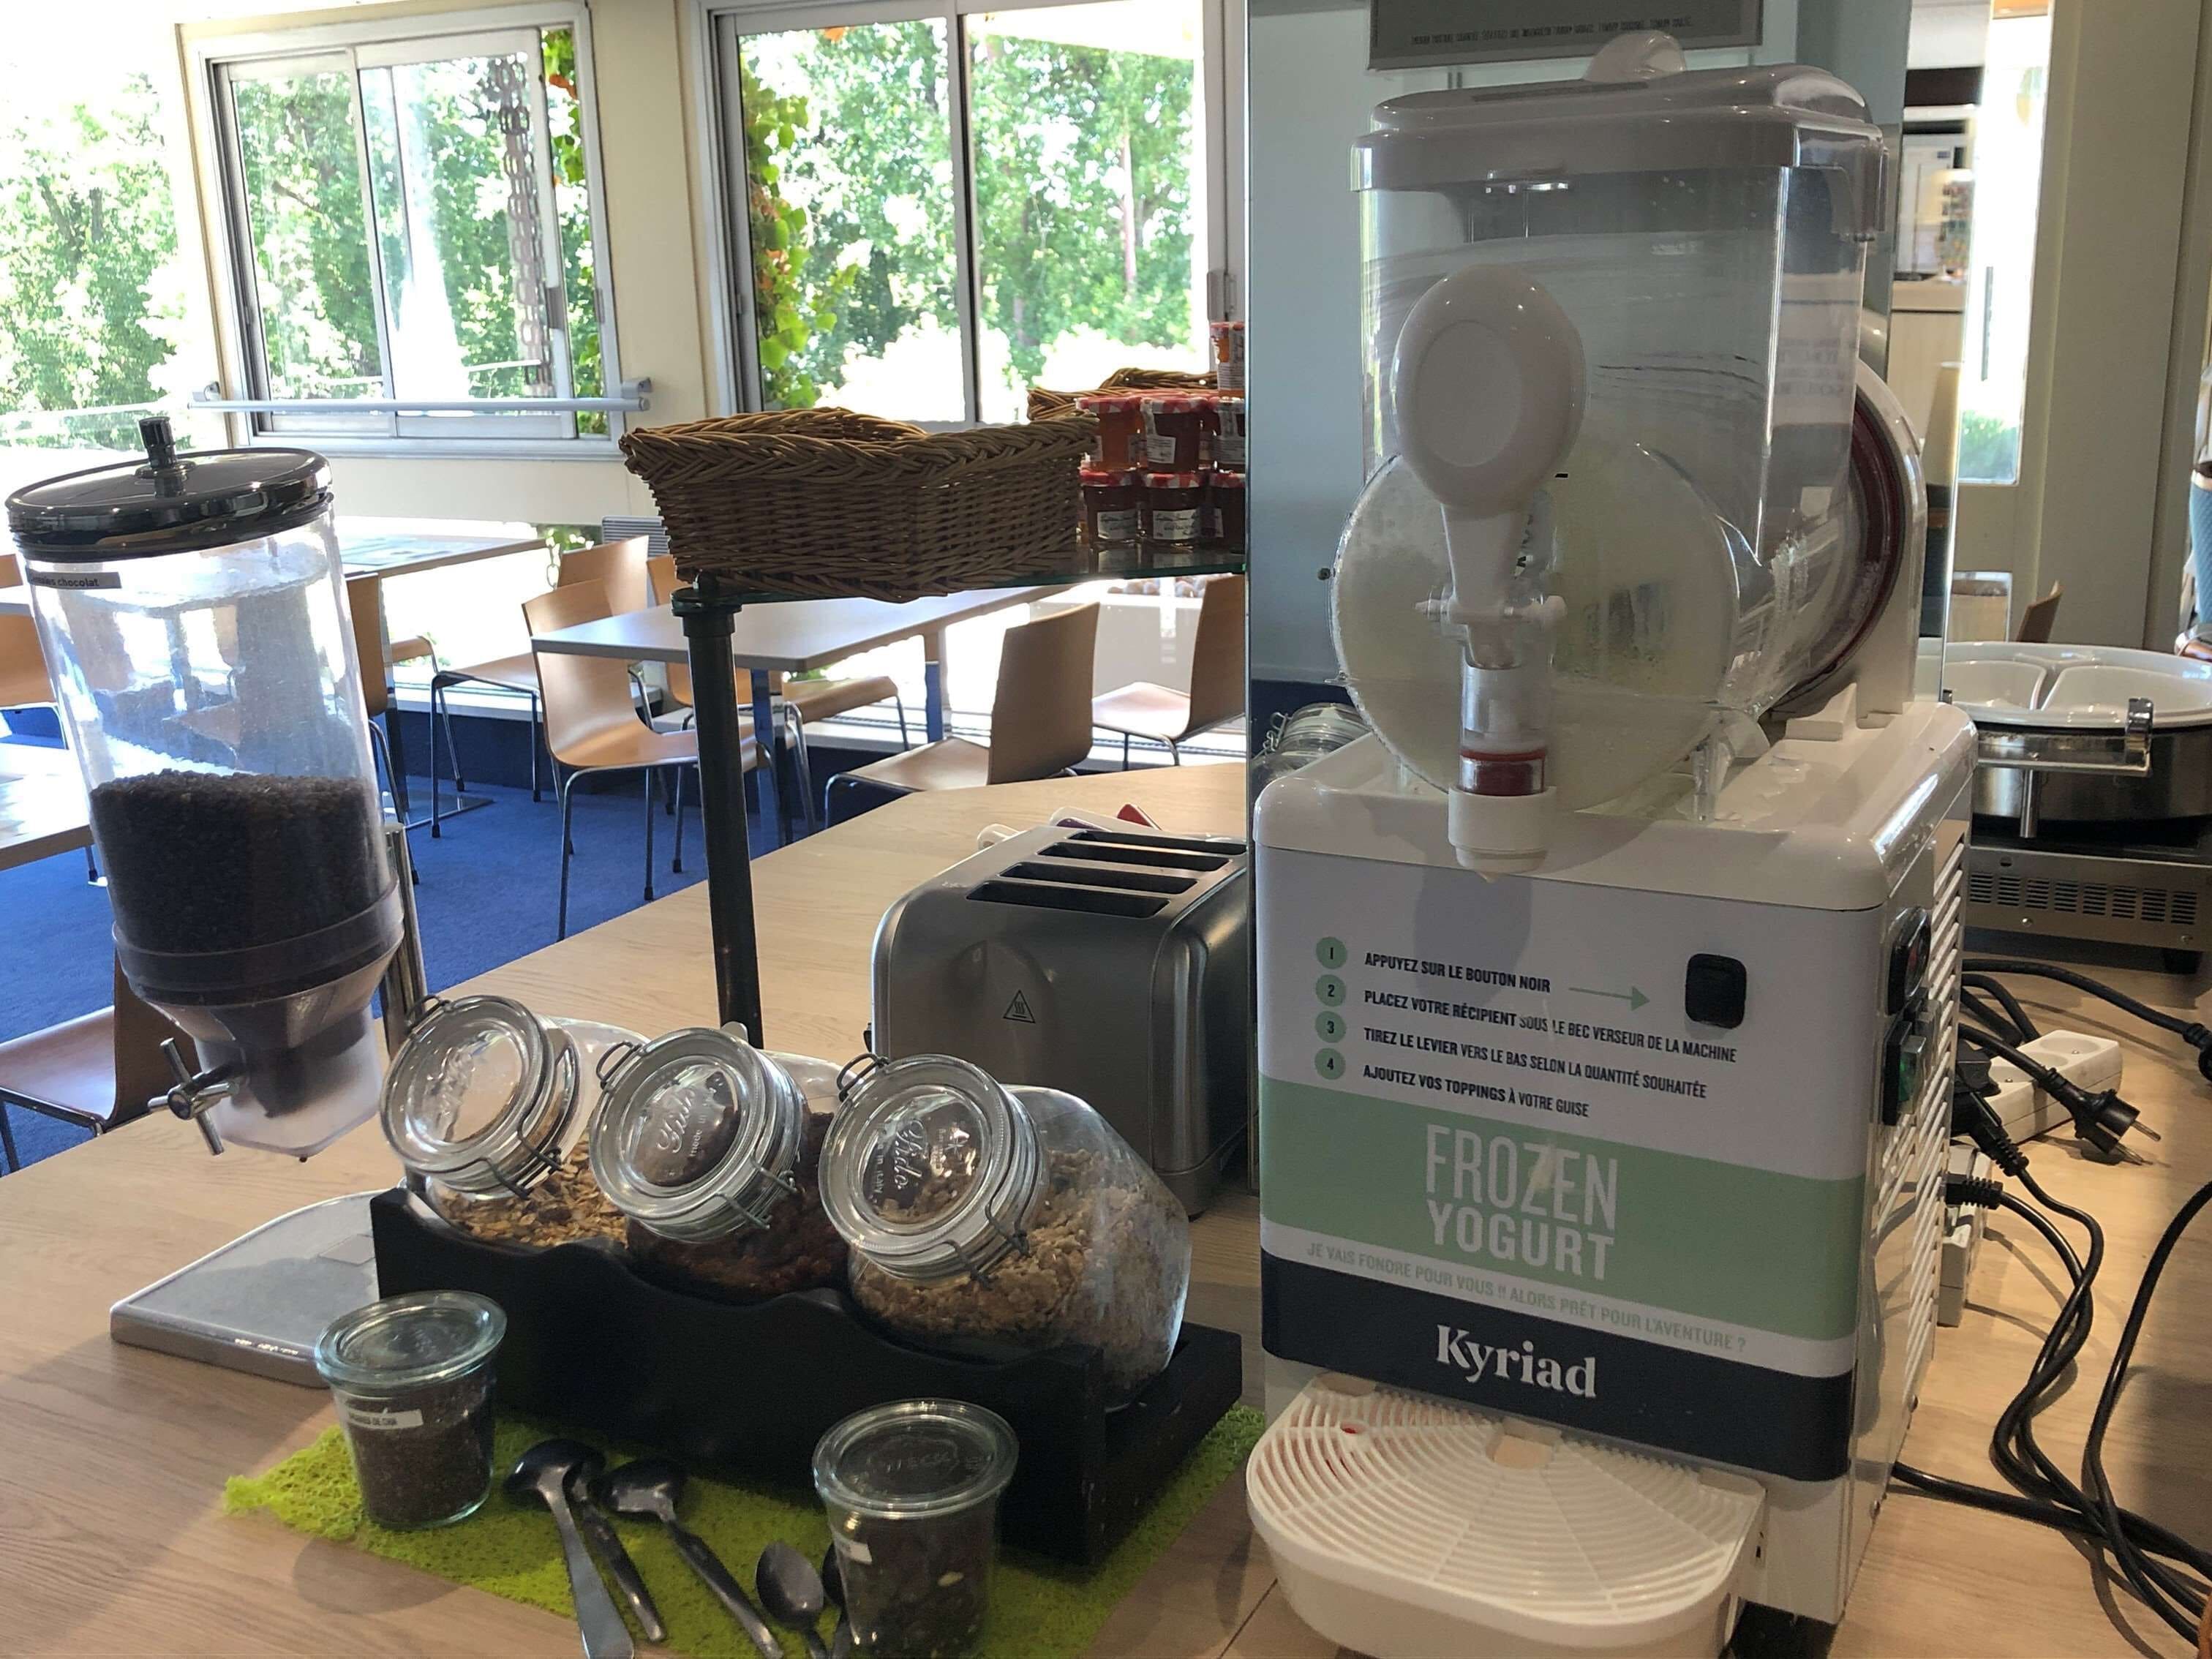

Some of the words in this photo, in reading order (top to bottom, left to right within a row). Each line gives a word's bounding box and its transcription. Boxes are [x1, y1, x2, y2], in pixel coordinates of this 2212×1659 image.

[57, 576, 99, 587] chocolat
[1364, 952, 1418, 973] APPUYEZ
[1421, 961, 1445, 977] SUR
[1448, 965, 1463, 979] LE
[1465, 967, 1516, 988] BOUTON
[1519, 975, 1551, 993] NOIR
[1327, 985, 1335, 998] 2
[1364, 990, 1409, 1010] PLACEZ
[1411, 997, 1450, 1016] VOTRE
[1453, 1002, 1517, 1027] RÉCIPIENT
[1519, 1015, 1549, 1032] SOUS
[1552, 1020, 1565, 1034] LE
[1568, 1023, 1590, 1039] BEC
[1592, 1026, 1644, 1048] VERSEUR
[1647, 1034, 1663, 1051] DE
[1665, 1037, 1679, 1053] LA
[1682, 1040, 1737, 1063] MACHINE
[1327, 1020, 1335, 1034] 3
[1363, 1027, 1397, 1045] TIREZ
[1399, 1033, 1415, 1047] LE
[1416, 1036, 1459, 1056] LEVIER
[1460, 1043, 1488, 1061] VERS
[1490, 1048, 1503, 1064] LE
[1506, 1050, 1528, 1068] BAS
[1530, 1056, 1565, 1074] SELON
[1568, 1062, 1582, 1077] LA
[1584, 1064, 1640, 1088] QUANTITÉ
[1642, 1074, 1708, 1098] SOUHAITÉE
[1326, 1057, 1334, 1070] 4
[1363, 1064, 1416, 1086] AJOUTEZ
[1418, 1074, 1442, 1091] VOS
[1445, 1079, 1505, 1102] TOPPINGS
[1508, 1087, 1516, 1105] À
[1519, 1091, 1553, 1111] VOTRE
[1556, 1099, 1590, 1118] GUISE
[1426, 1124, 1618, 1230] FROZEN
[1426, 1199, 1616, 1281] YOGURT
[1306, 1243, 1323, 1257] JE
[1325, 1246, 1355, 1263] VAIS
[1358, 1253, 1412, 1278] FONDRE
[1415, 1265, 1453, 1287] POUR
[1456, 1274, 1494, 1295] VOUS
[1509, 1287, 1556, 1311] ALORS
[1560, 1298, 1596, 1320] PRÊT
[1600, 1306, 1641, 1331] POUR
[1645, 1317, 1734, 1349] L'AVENTURE
[1737, 1336, 1746, 1353] ?
[1437, 1324, 1597, 1398] Kyriad
